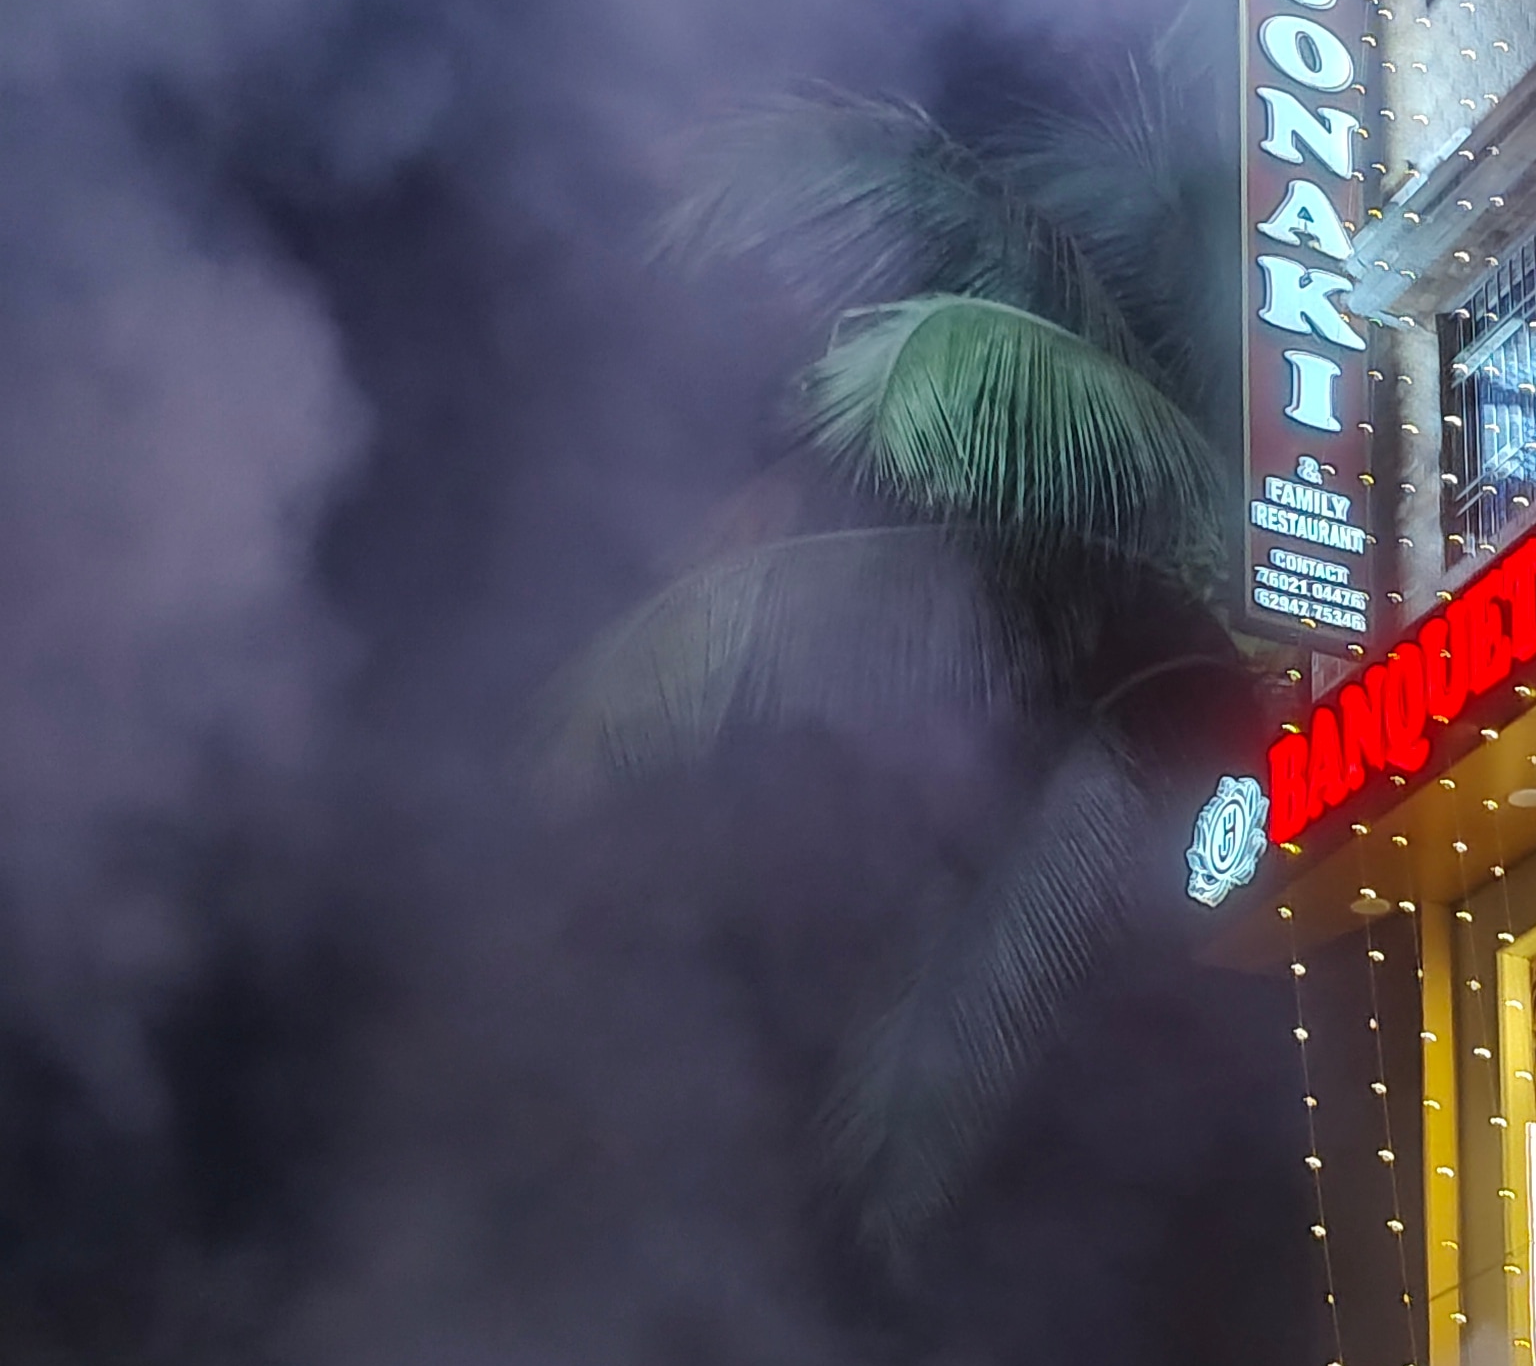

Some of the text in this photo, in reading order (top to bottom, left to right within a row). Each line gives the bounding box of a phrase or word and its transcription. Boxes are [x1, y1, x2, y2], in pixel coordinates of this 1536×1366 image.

[1297, 455, 1323, 485] &
[1265, 476, 1351, 522] FAMILY
[1251, 501, 1366, 555] RESTAURANT
[1254, 566, 1310, 597] 76021
[1270, 548, 1350, 585] CONTACT
